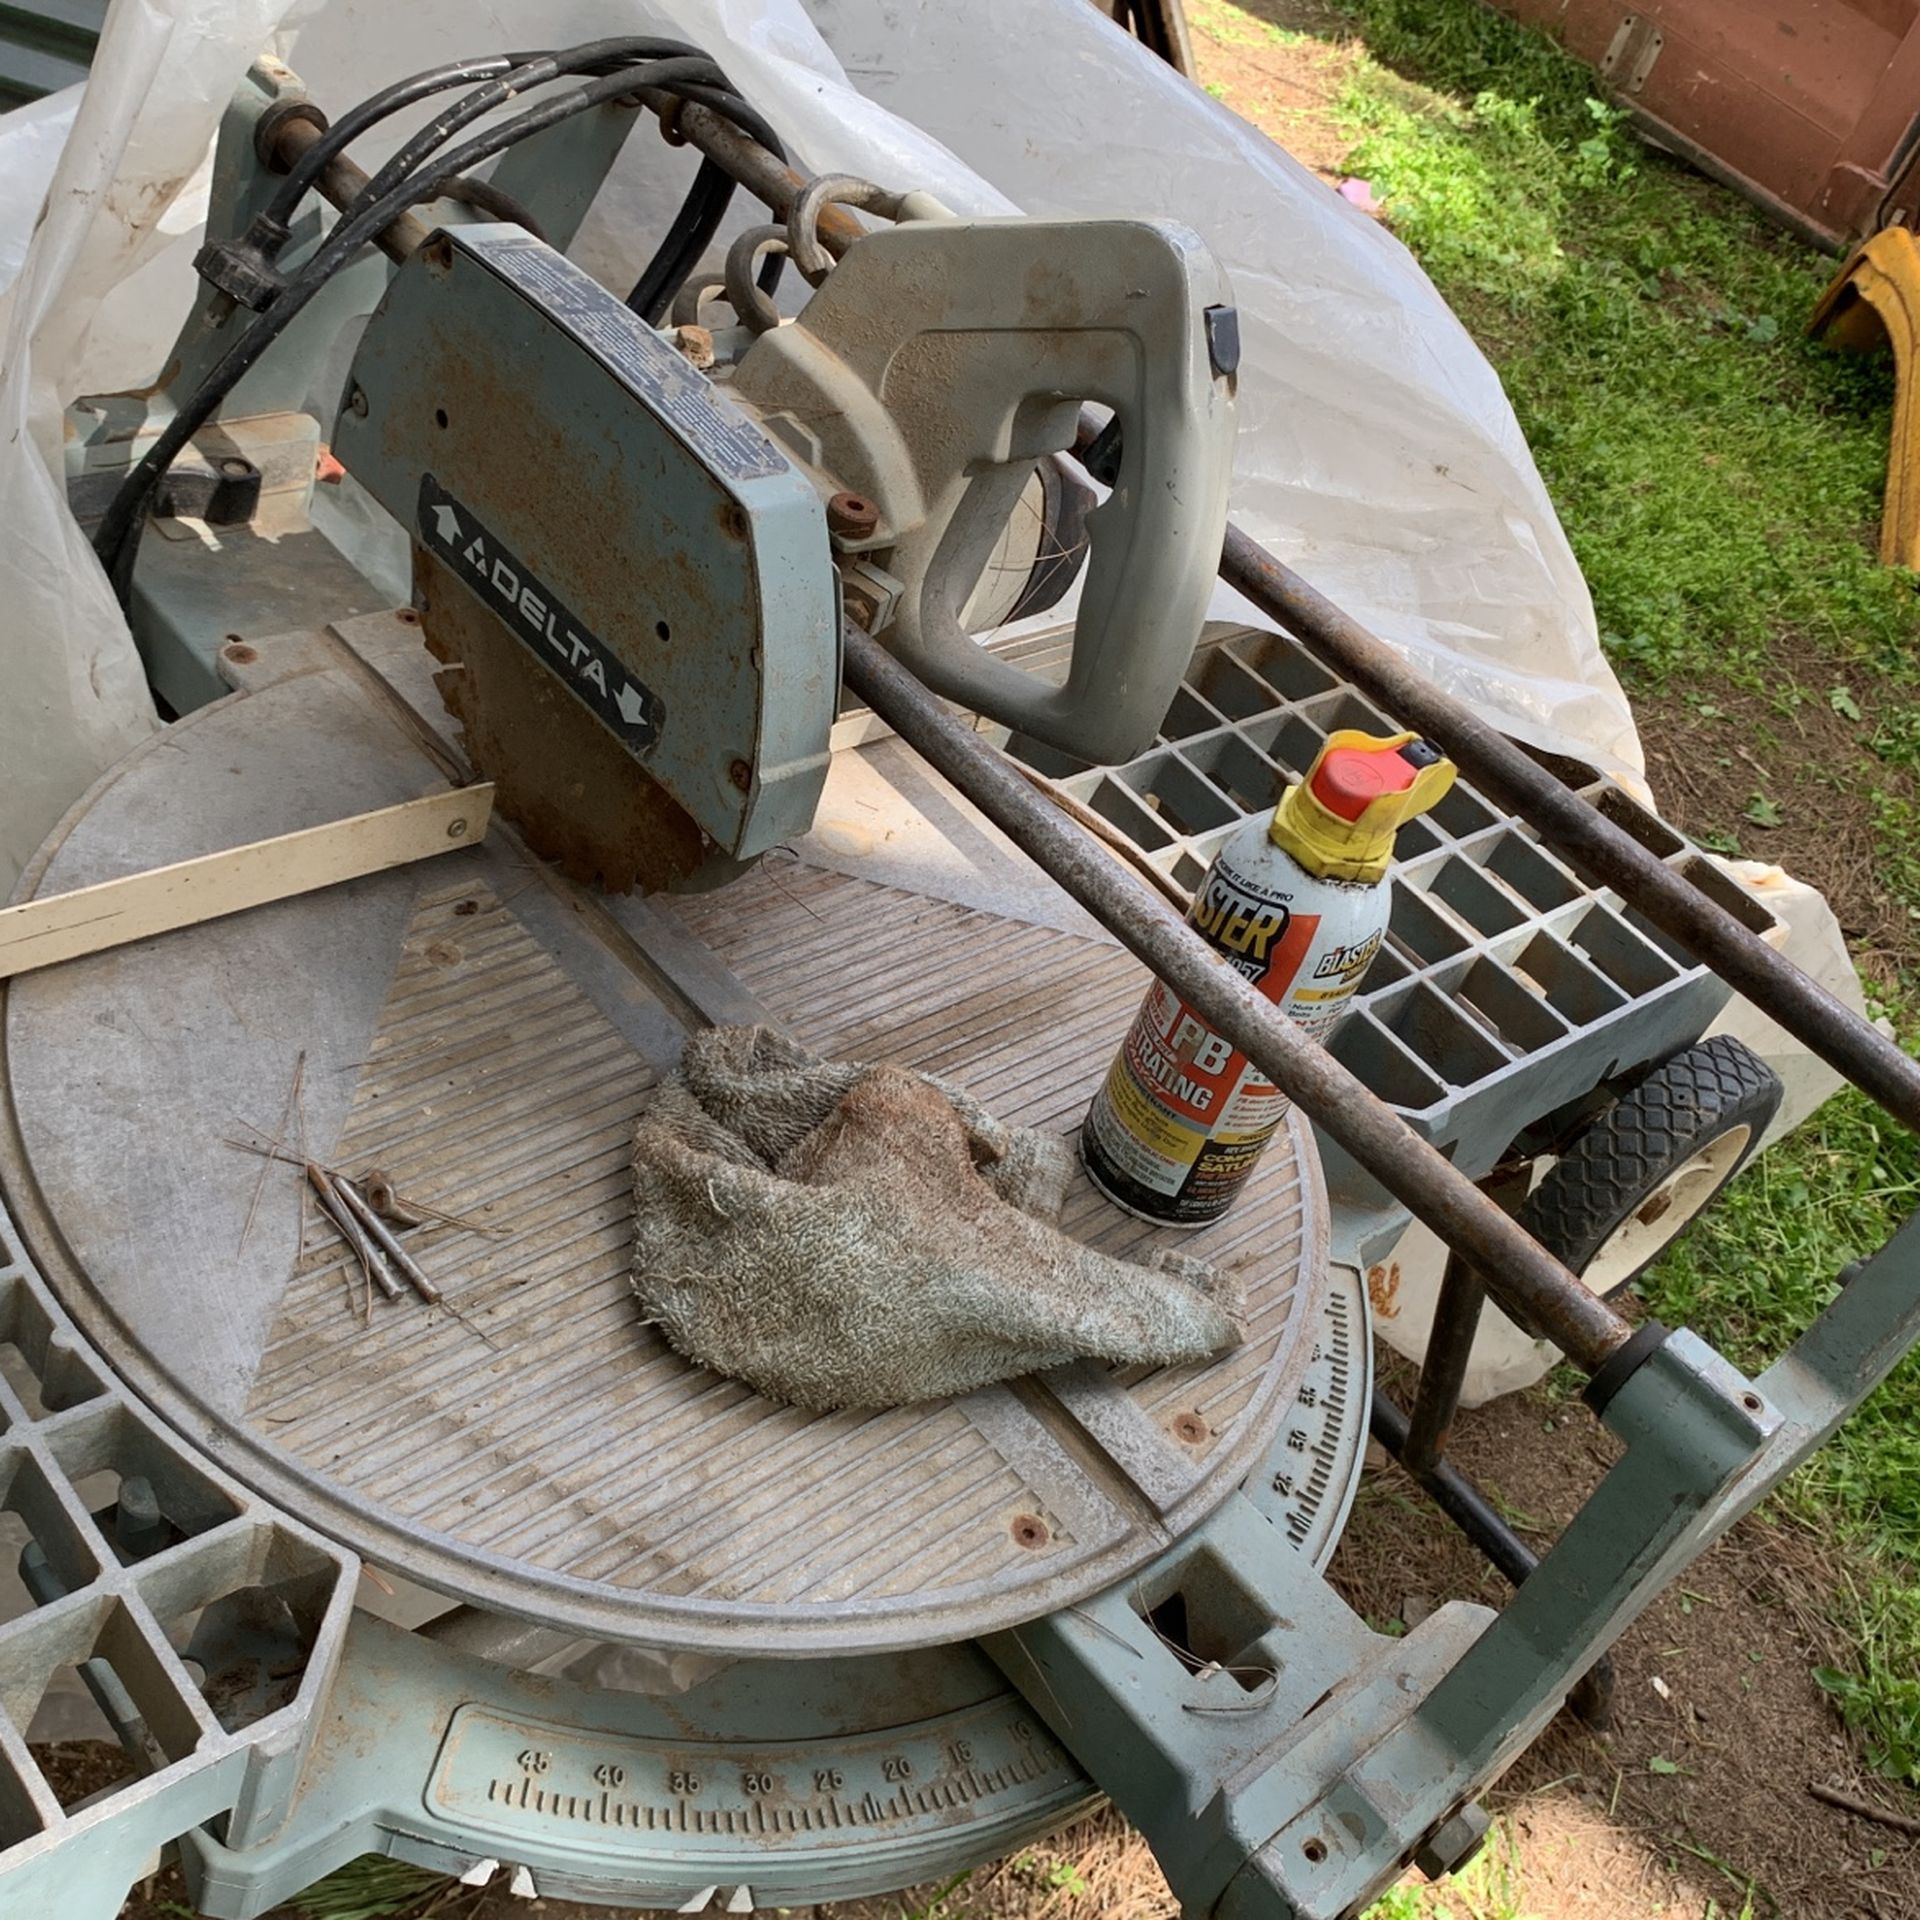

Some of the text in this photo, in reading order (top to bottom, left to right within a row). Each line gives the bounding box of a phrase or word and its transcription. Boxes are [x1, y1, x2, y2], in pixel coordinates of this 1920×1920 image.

[491, 558, 608, 699] DELTA
[1193, 876, 1286, 960] STER
[1240, 877, 1262, 893] LIKE
[1260, 887, 1269, 897] A
[1268, 890, 1294, 902] PRO
[1134, 1030, 1214, 1111] TRATING
[1171, 1012, 1235, 1076] PB
[517, 1749, 550, 1775] 45
[593, 1764, 626, 1788] 40
[671, 1771, 700, 1794] 35
[745, 1771, 774, 1795] 30
[816, 1768, 844, 1791] 25
[883, 1757, 912, 1781] 20
[948, 1740, 975, 1765] 15
